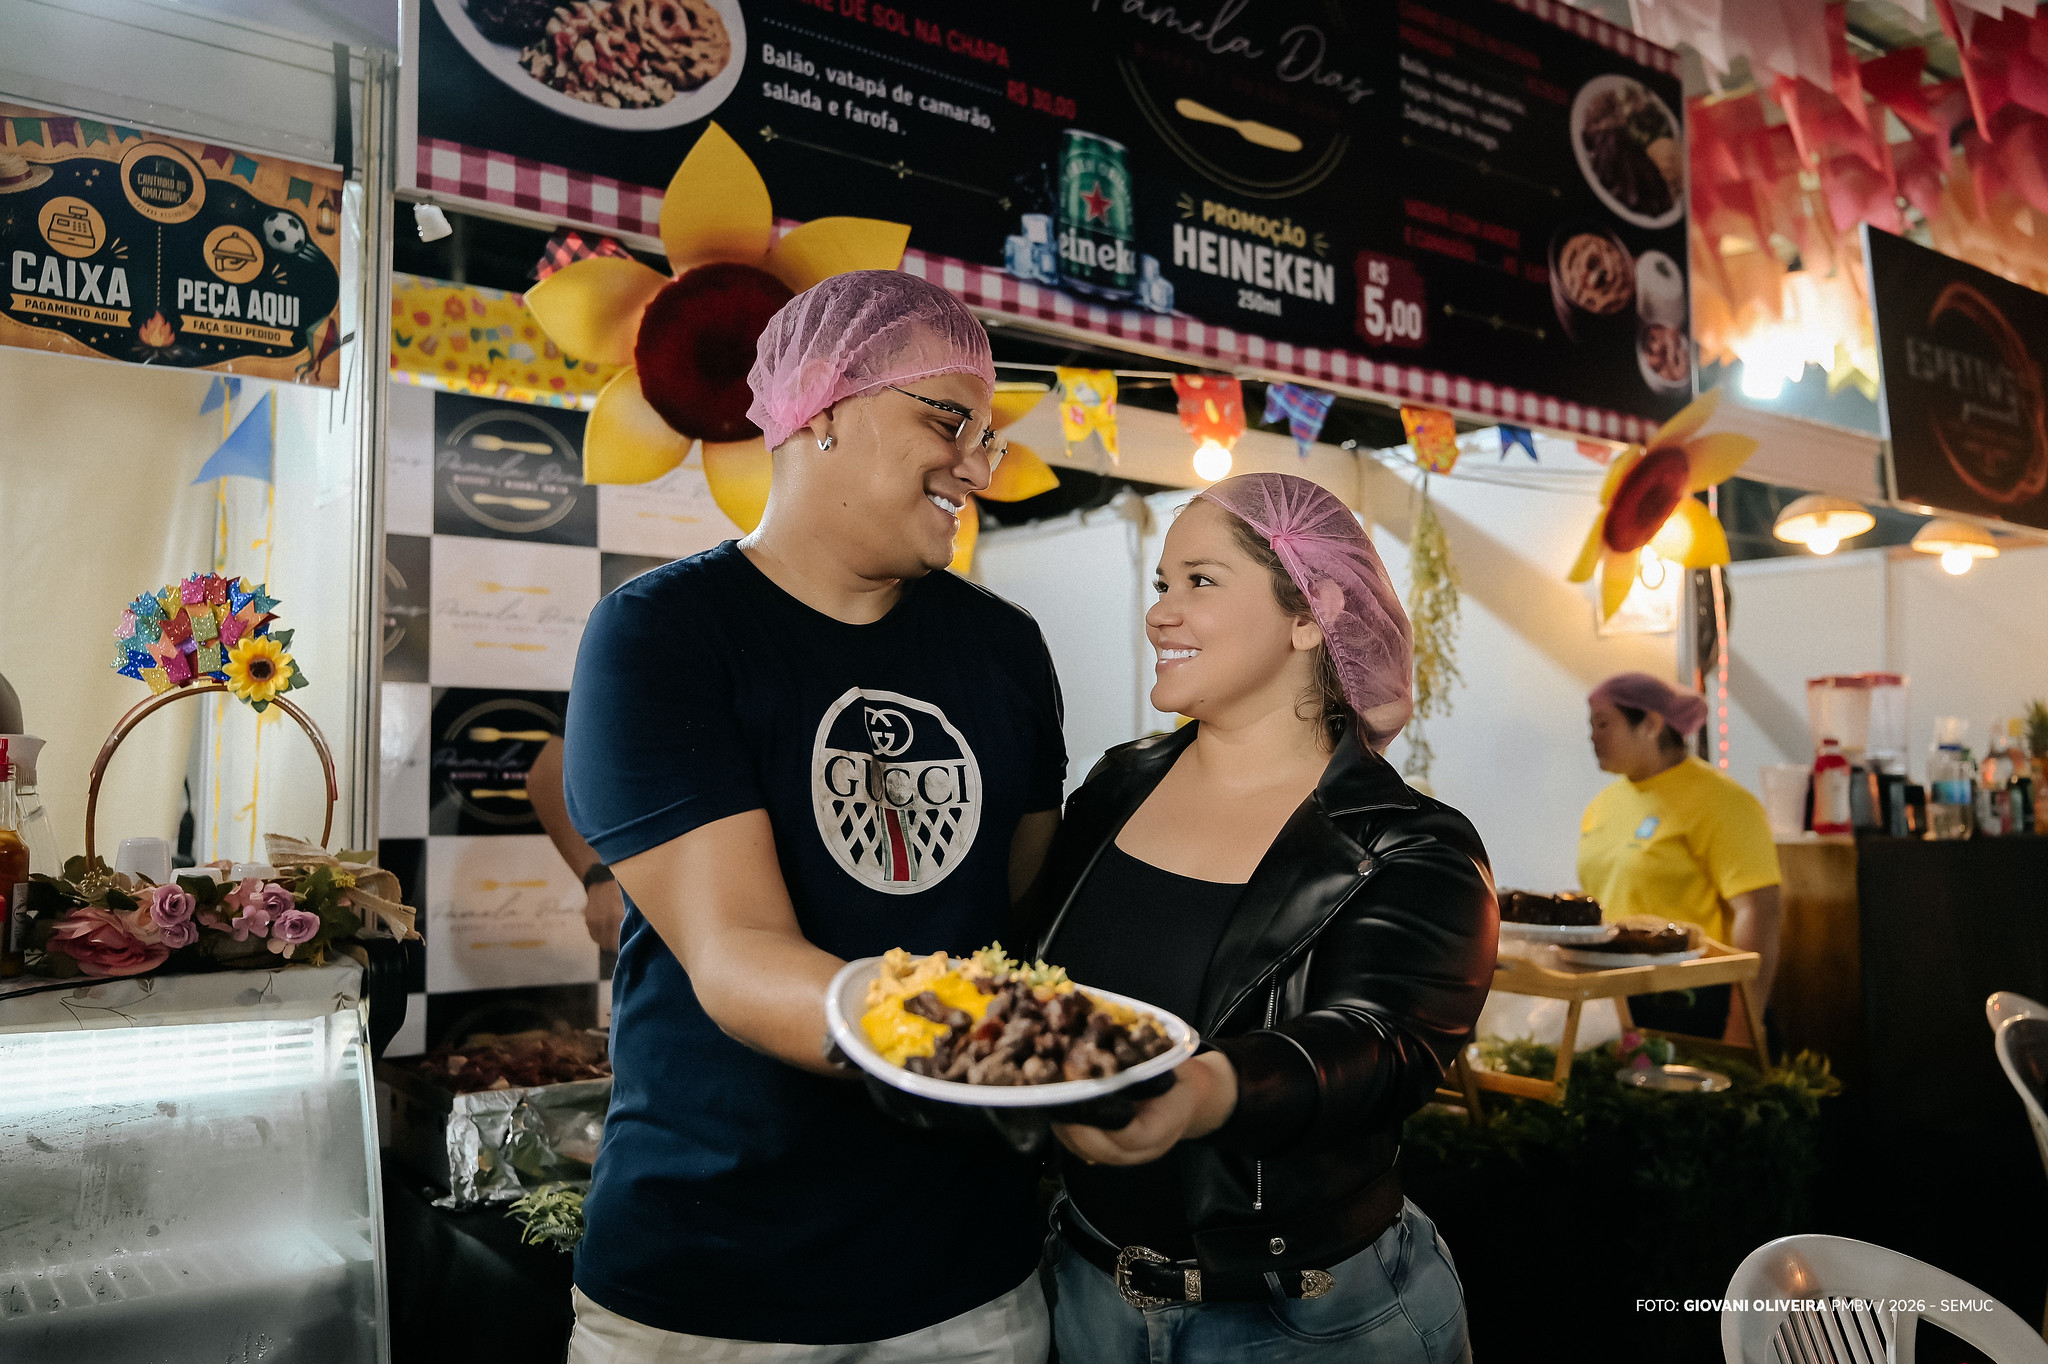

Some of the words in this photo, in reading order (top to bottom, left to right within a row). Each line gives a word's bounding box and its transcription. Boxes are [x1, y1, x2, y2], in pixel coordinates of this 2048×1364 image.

[872, 3, 910, 36] SOL
[914, 17, 942, 46] NA
[946, 28, 1010, 69] CHAPA
[1091, 0, 1264, 59] amela
[762, 81, 823, 113] salada
[827, 100, 839, 117] e
[825, 66, 887, 99] vatapá
[892, 84, 914, 106] de
[918, 95, 996, 134] camarão,
[1202, 200, 1307, 249] PROMOÇÃO
[12, 250, 131, 307] CAIXA
[1173, 222, 1335, 306] HEINEKEN
[24, 299, 91, 318] PAGAMENTO
[93, 311, 120, 323] AQUI
[177, 277, 241, 319] PEÇA
[246, 289, 300, 328] AQUI
[1363, 284, 1423, 343] 5,00
[193, 320, 220, 334] FAÇA
[222, 324, 243, 336] SEU
[245, 329, 282, 342] PEDIDO
[824, 755, 970, 807] GUCCI
